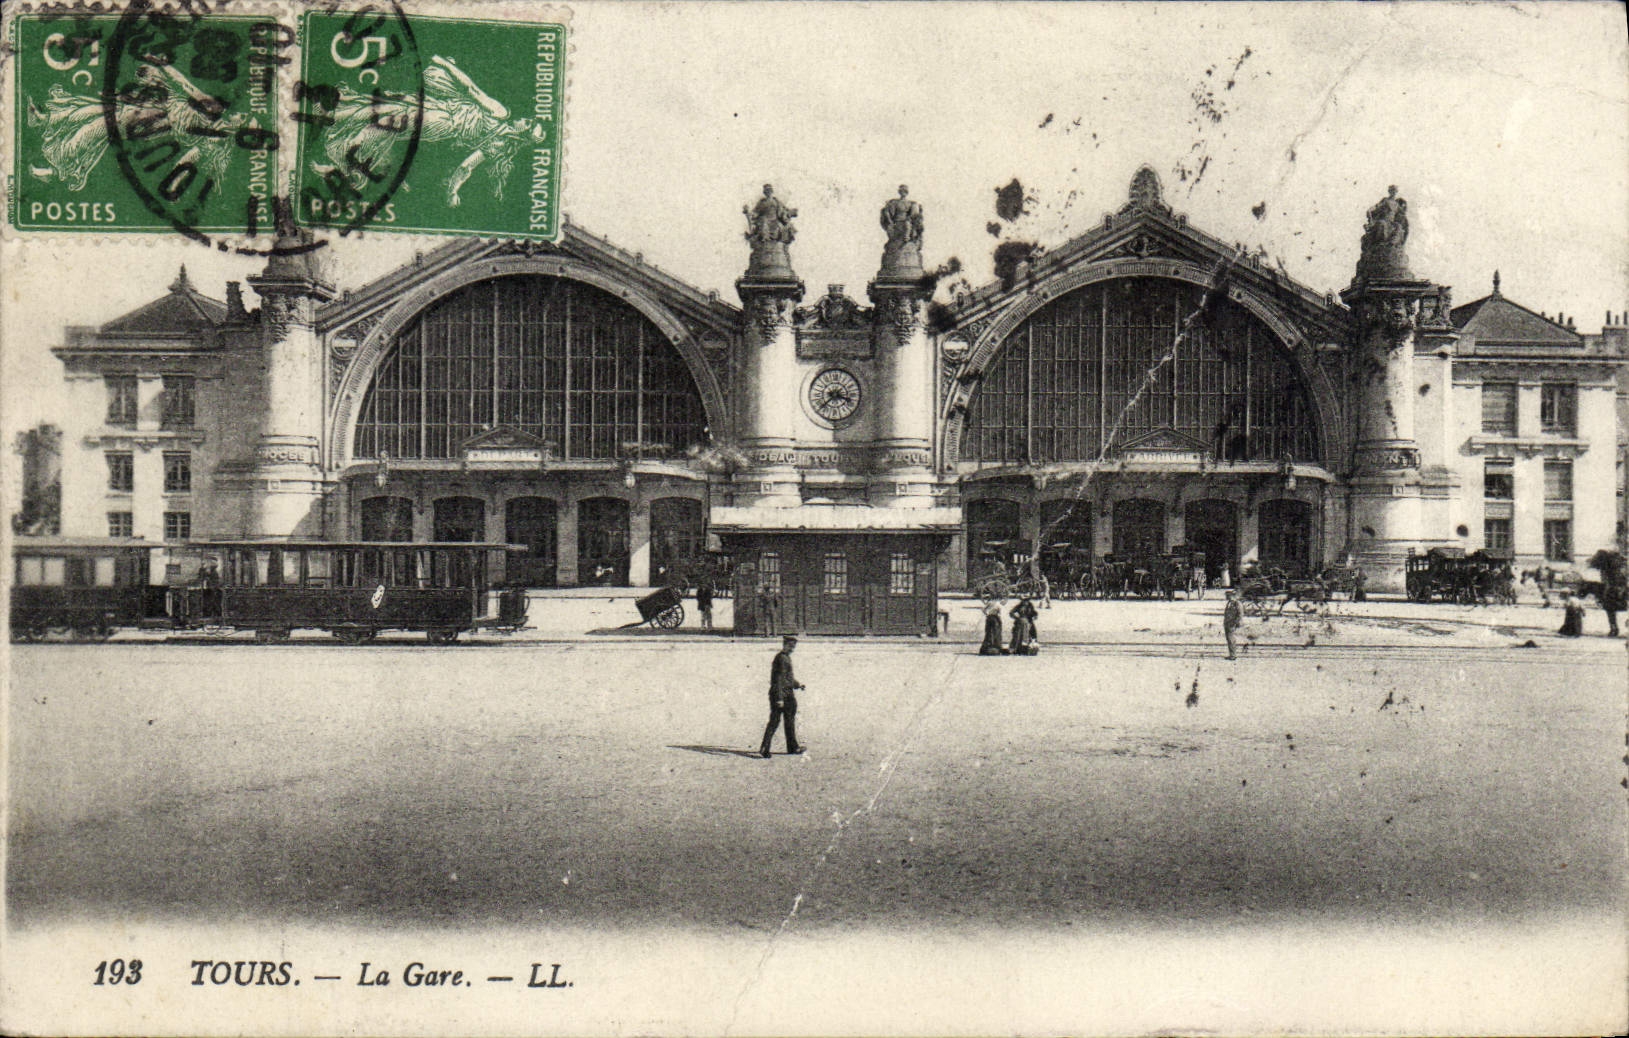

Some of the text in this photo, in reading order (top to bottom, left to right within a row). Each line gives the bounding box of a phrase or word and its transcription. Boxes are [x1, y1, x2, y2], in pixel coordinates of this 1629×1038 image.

[529, 32, 556, 231] REPUBLIQUE FRANÇAISE
[31, 201, 117, 223] POSTES
